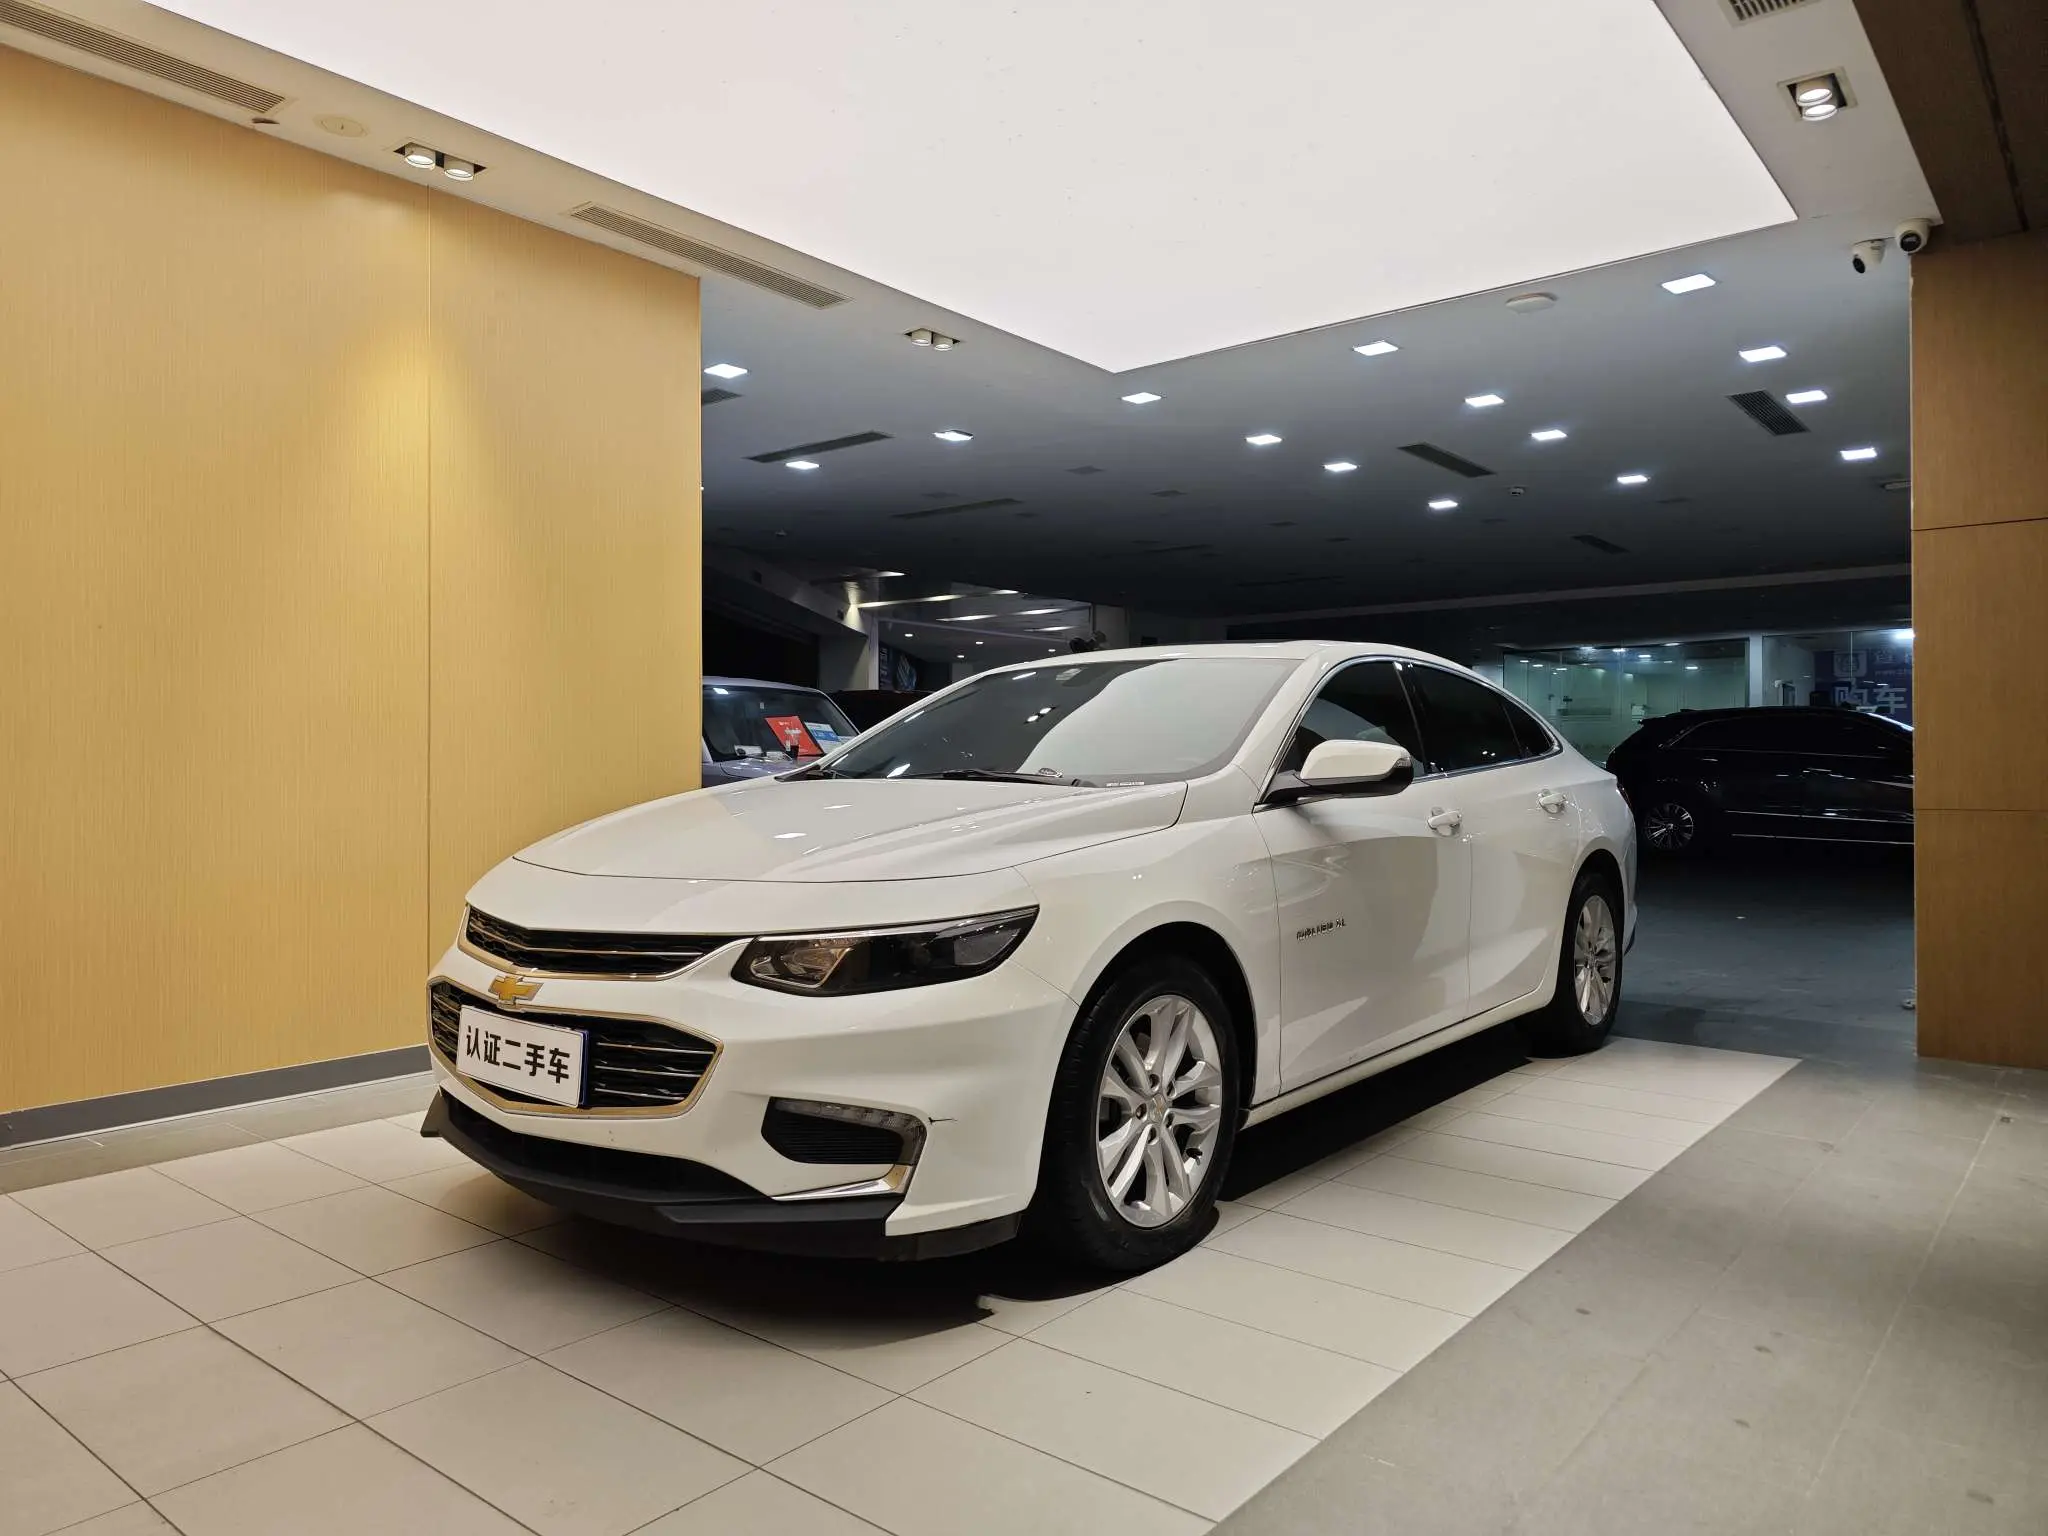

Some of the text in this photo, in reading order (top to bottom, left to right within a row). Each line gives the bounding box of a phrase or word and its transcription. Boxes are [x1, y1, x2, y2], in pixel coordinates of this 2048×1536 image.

[465, 1025, 571, 1084] 认证二手车
